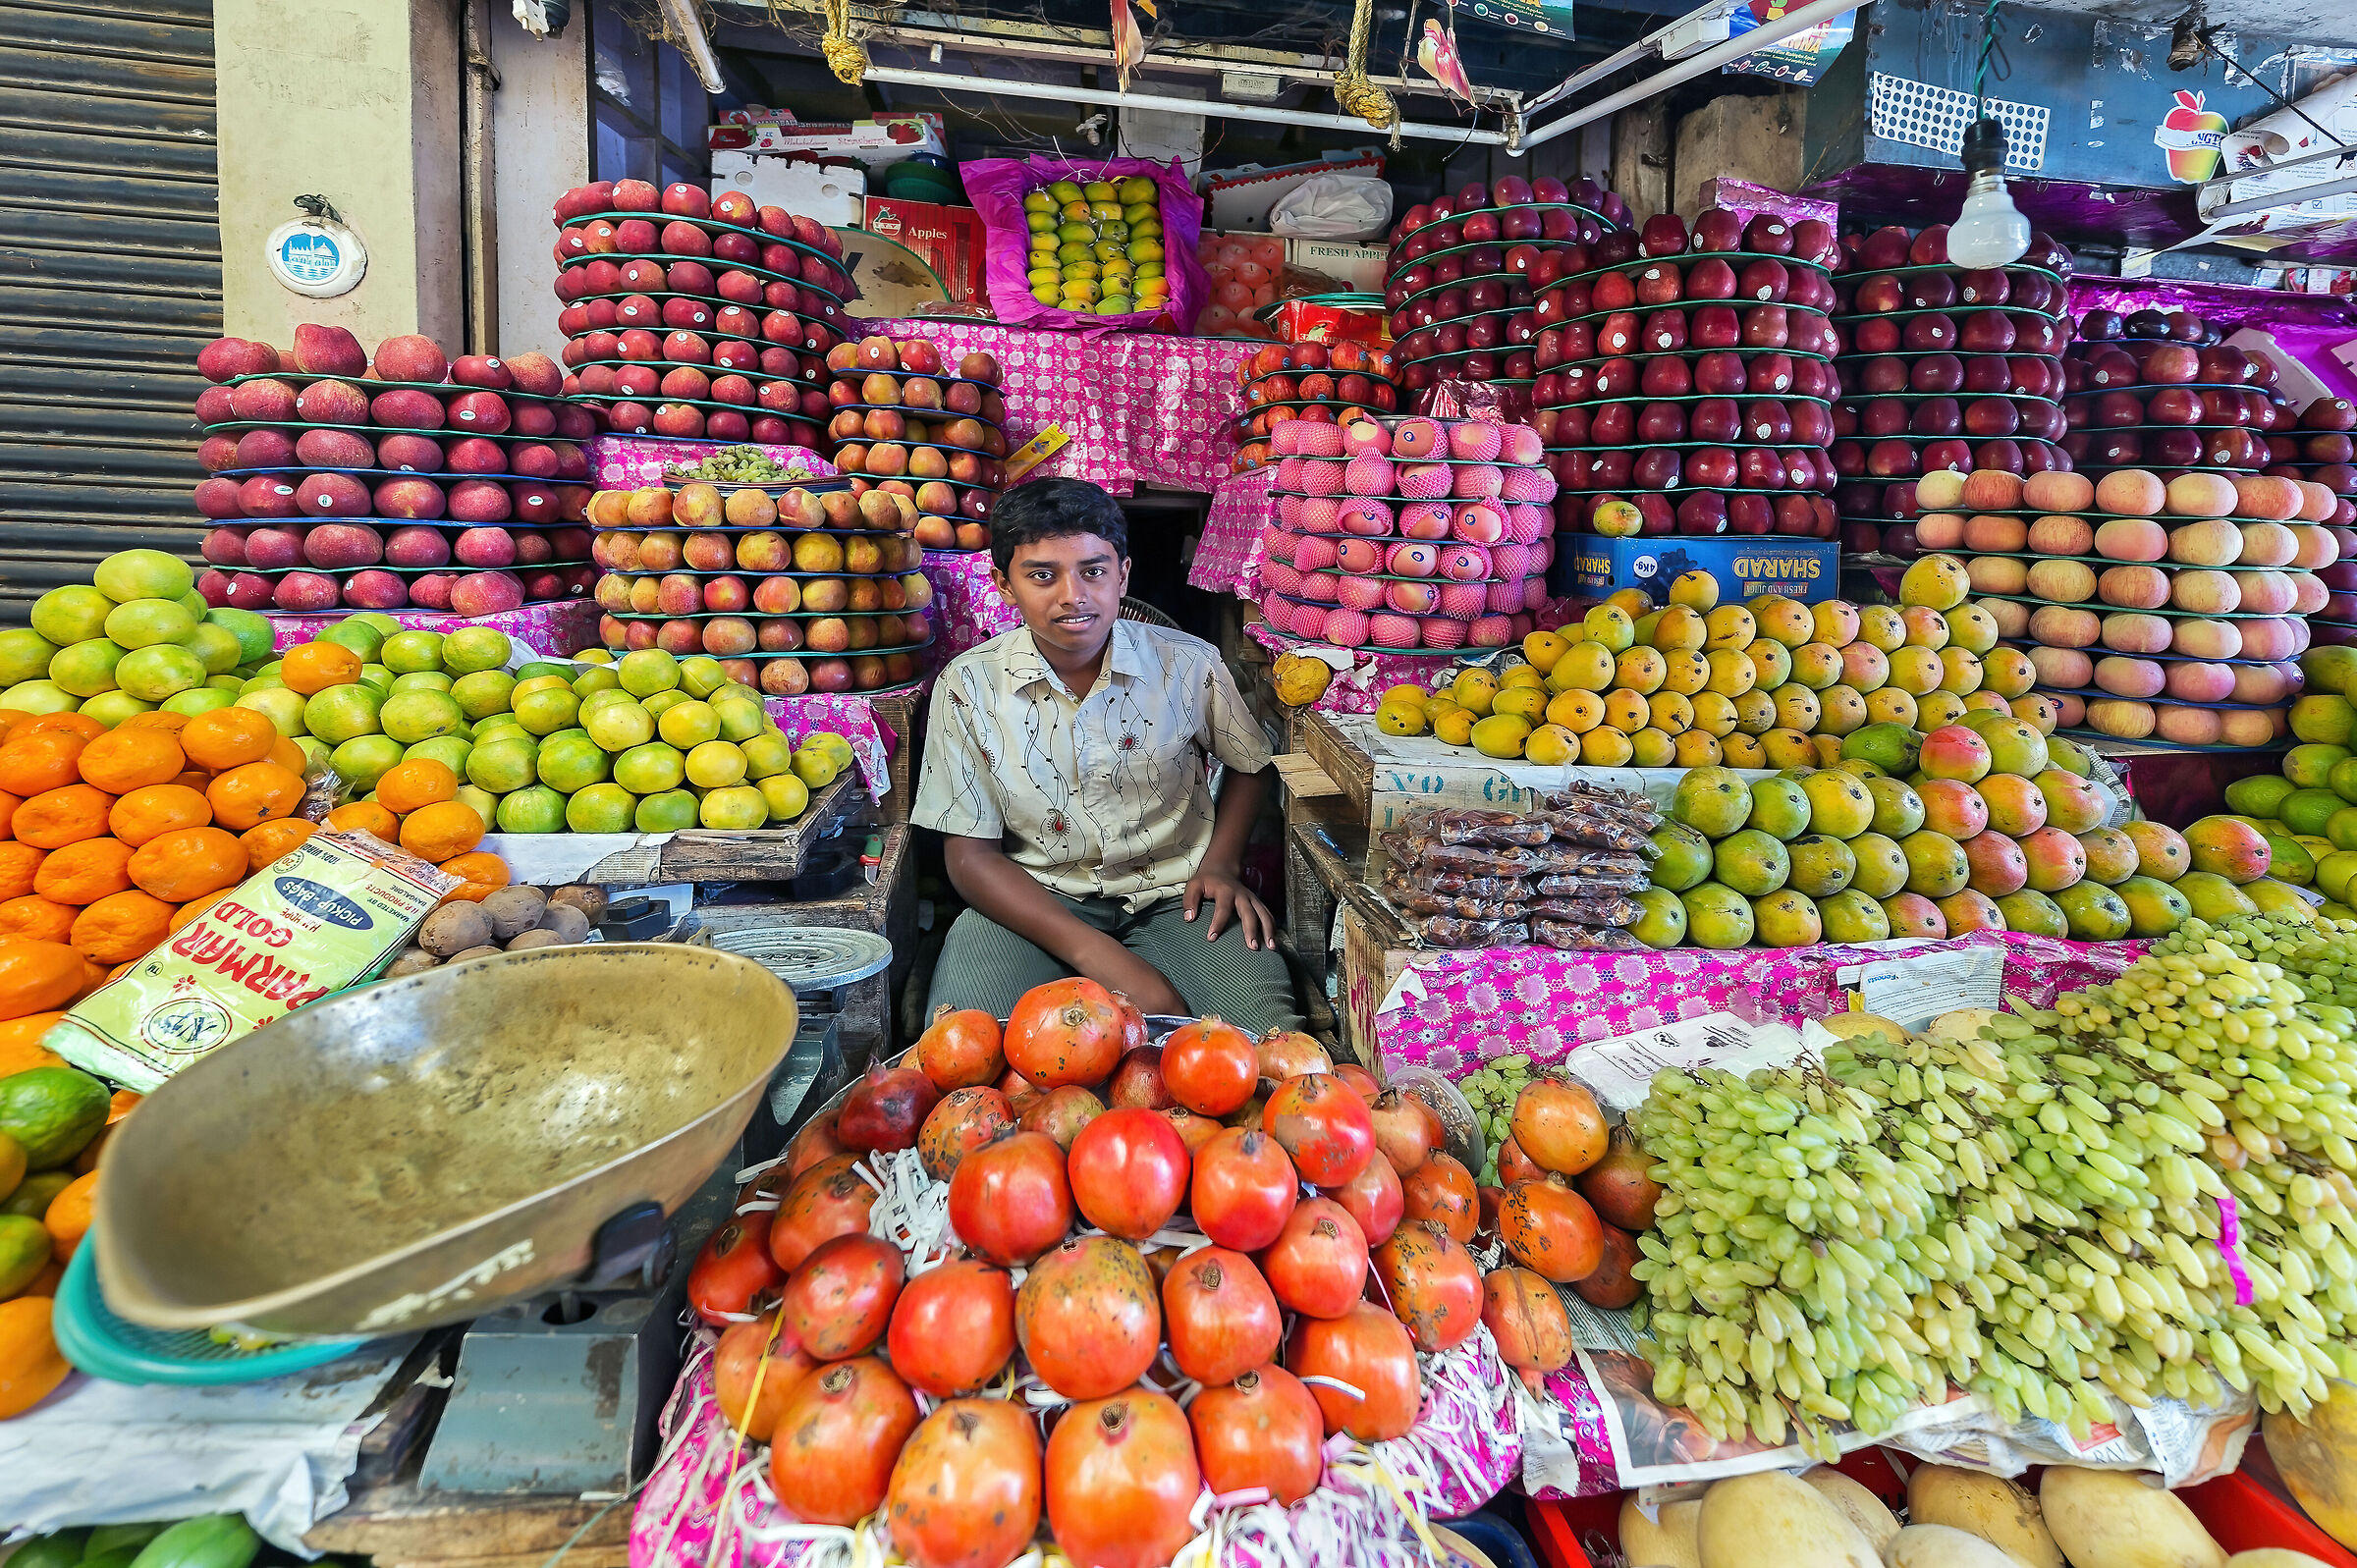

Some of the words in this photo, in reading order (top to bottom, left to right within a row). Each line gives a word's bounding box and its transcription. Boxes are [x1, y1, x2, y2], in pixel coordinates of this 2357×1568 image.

[907, 226, 948, 241] Apples
[1310, 246, 1349, 257] FRESH
[1574, 559, 1612, 574] SHARAD
[1732, 557, 1822, 578] SHARAD
[1768, 584, 1784, 593] AND
[1784, 585, 1808, 594] FRESH
[364, 884, 405, 909] PRODUCTS
[389, 884, 427, 907] BANGALORE
[379, 900, 410, 923] MARKETED
[214, 901, 294, 947] GOLD
[171, 921, 331, 1011] PARMAR
